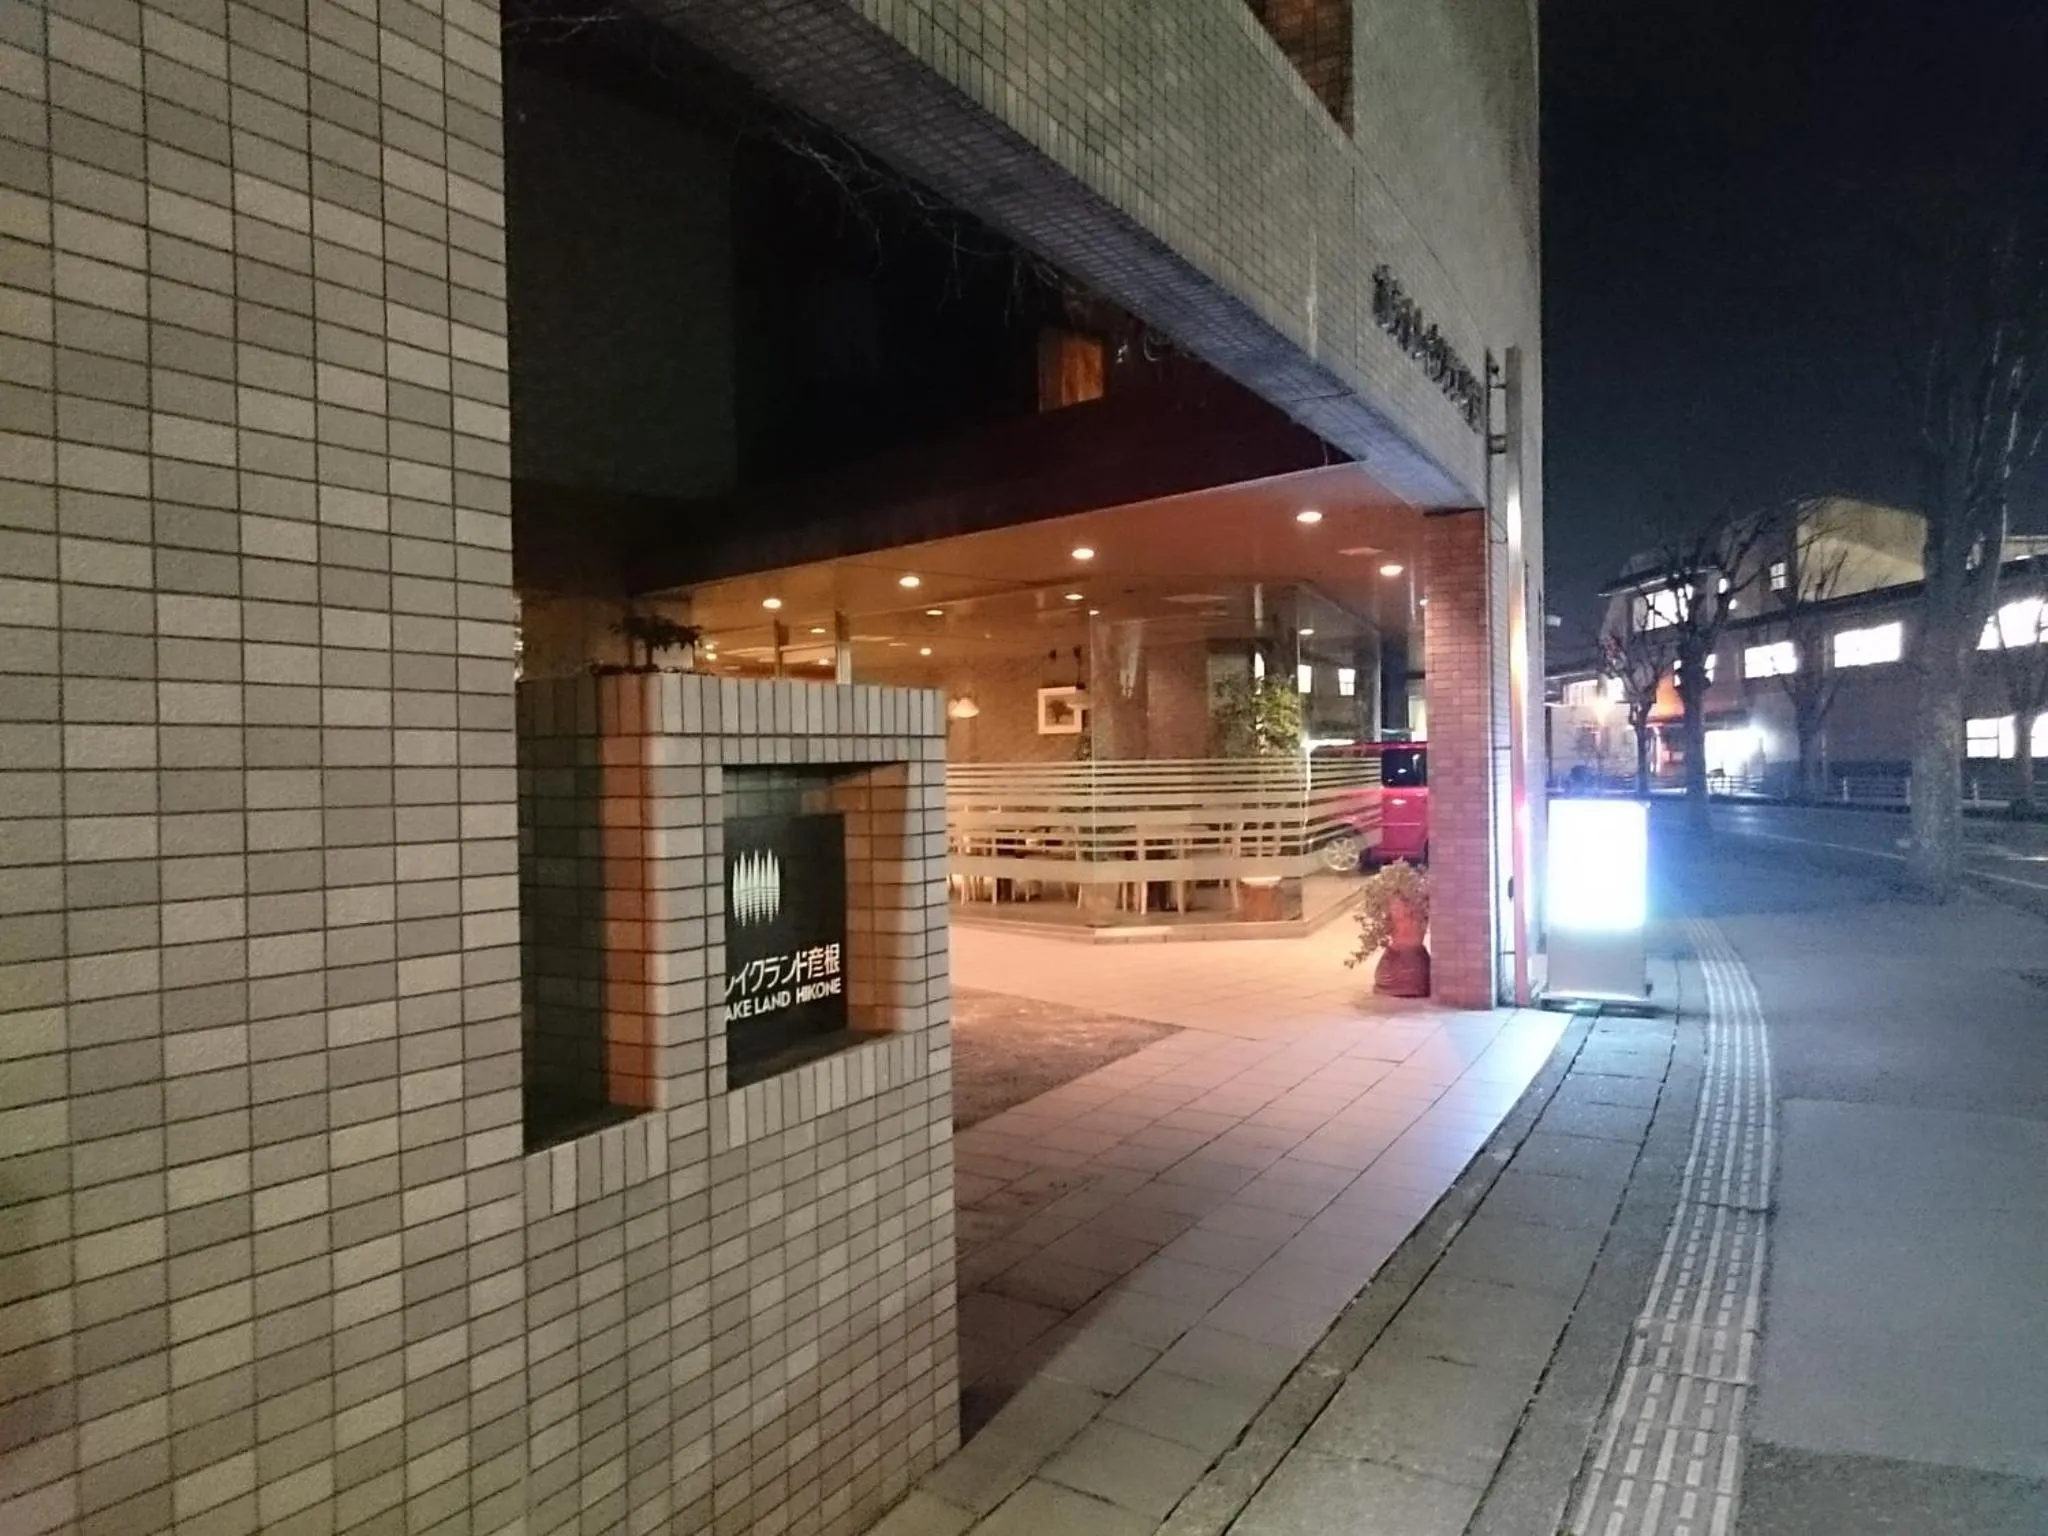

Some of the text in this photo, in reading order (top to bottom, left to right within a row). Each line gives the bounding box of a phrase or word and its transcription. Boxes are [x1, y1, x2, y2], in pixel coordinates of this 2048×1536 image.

[725, 978, 841, 1021] AKE LAND HIKONE
